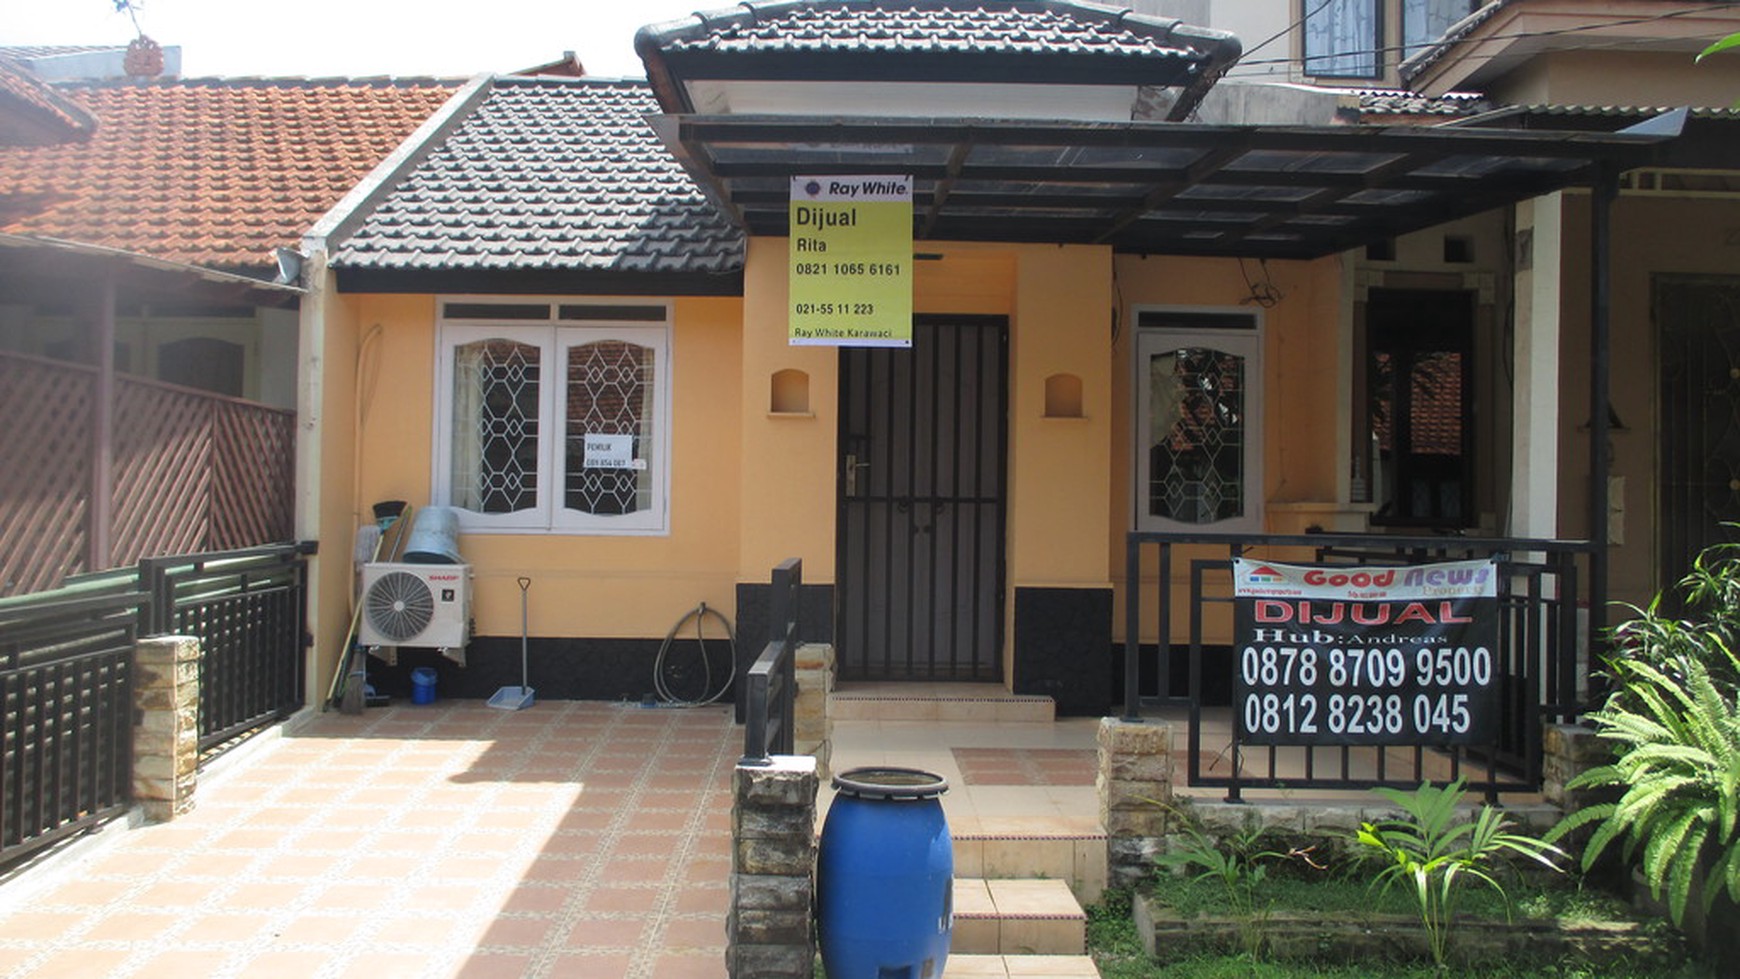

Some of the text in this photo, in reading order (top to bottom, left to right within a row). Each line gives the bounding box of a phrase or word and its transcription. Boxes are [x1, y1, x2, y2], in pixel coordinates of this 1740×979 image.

[829, 181, 859, 197] Ray
[796, 206, 856, 231] Dijual
[796, 238, 827, 252] Rita
[796, 263, 900, 275] 0821 1065 6161
[796, 303, 874, 315] 021-55 11 223
[794, 328, 893, 338] Ray White Karawaci
[1303, 569, 1396, 588] Good
[1254, 599, 1473, 626] DIJUAL
[1242, 647, 1491, 688] 0878 8709 9500
[1245, 693, 1470, 733] 0812 8238 045
